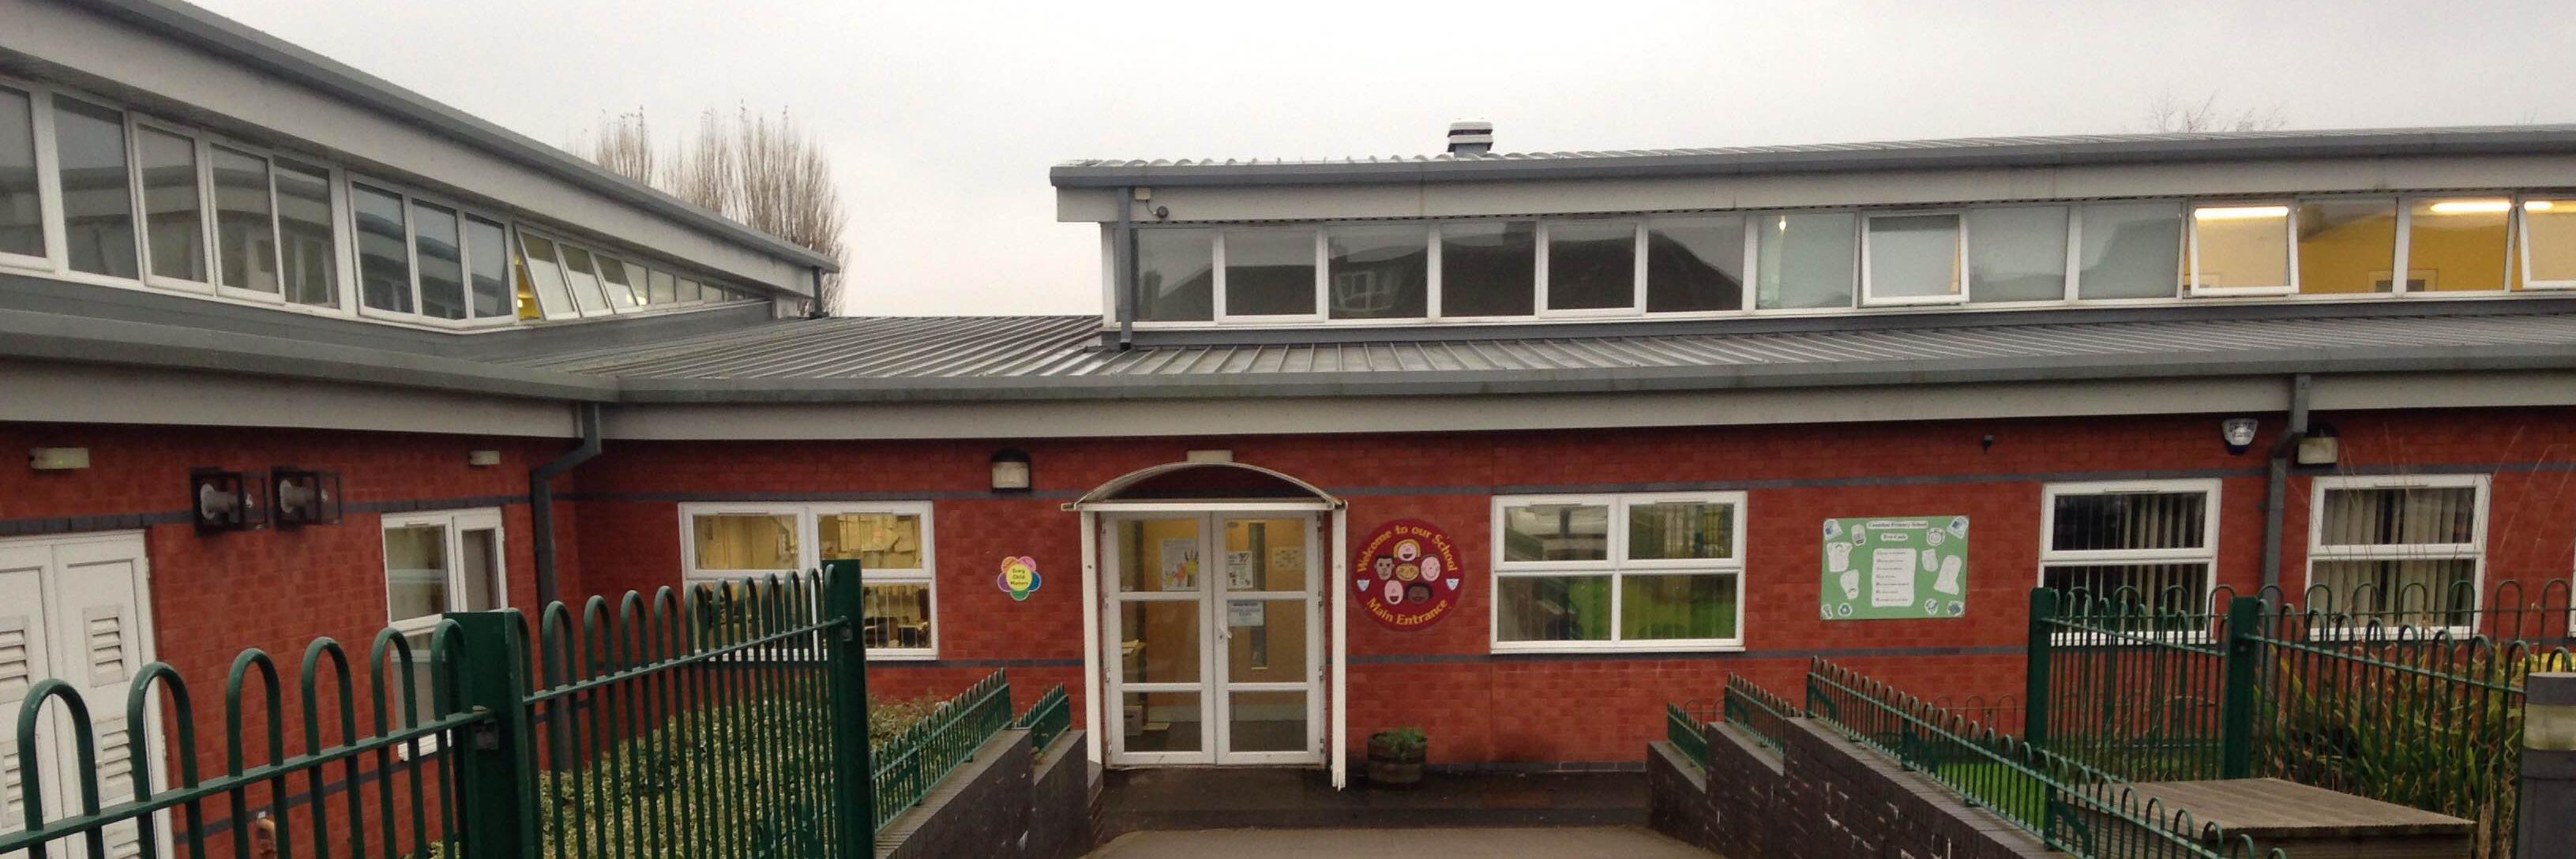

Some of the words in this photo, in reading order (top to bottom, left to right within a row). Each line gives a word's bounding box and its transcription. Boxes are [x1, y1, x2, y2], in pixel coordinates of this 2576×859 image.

[1357, 530, 1391, 572] Welcome
[1395, 524, 1408, 535] to
[1411, 526, 1433, 538] our
[1432, 534, 1458, 572] School
[1367, 597, 1394, 622] Main
[1396, 599, 1448, 625] Entrance
